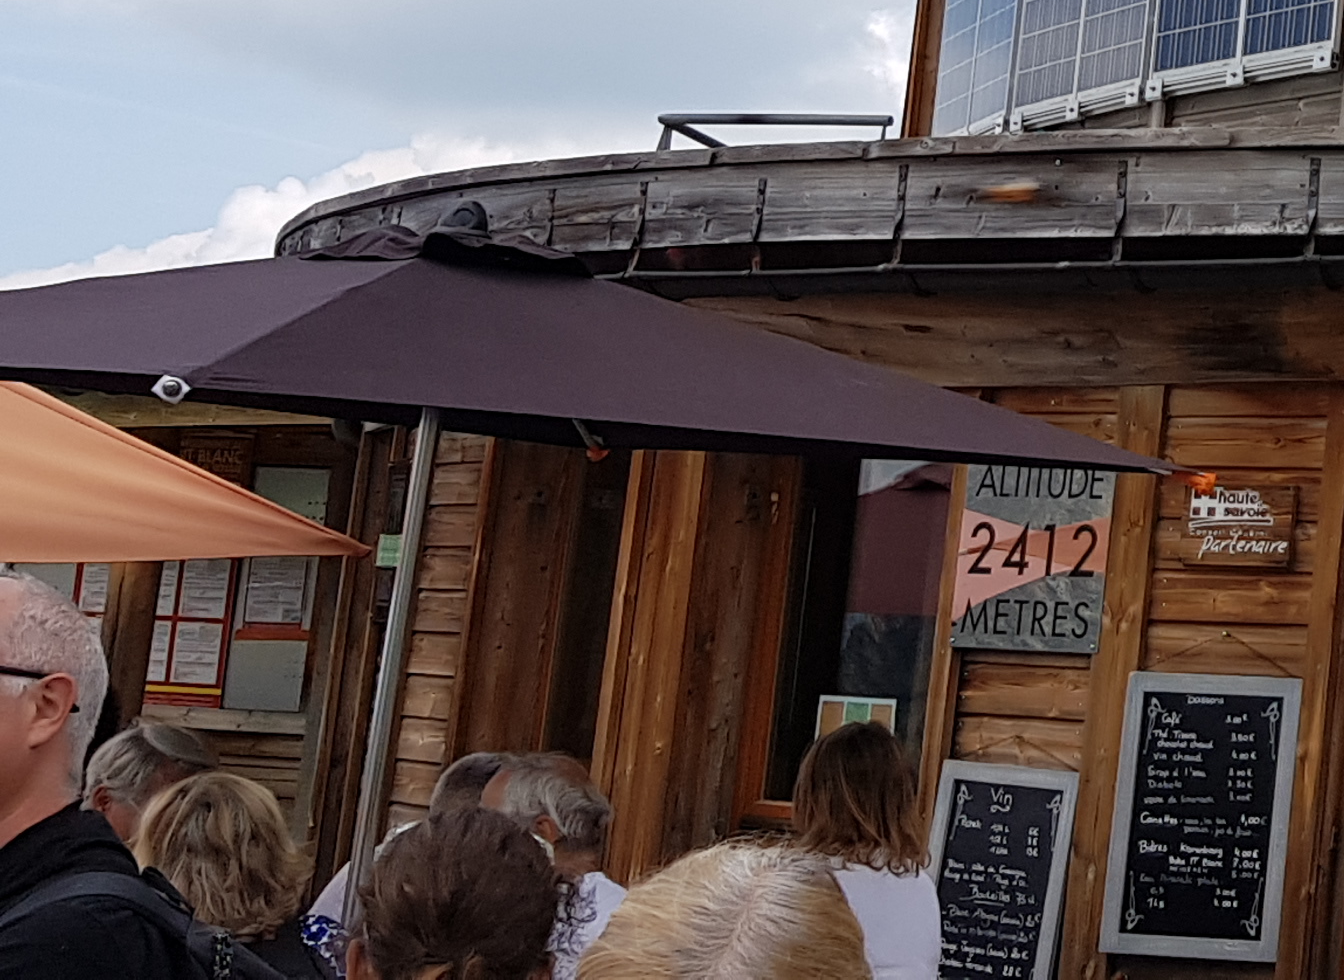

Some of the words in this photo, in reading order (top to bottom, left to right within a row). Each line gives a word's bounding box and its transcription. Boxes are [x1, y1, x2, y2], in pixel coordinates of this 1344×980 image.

[197, 448, 244, 464] BLANC
[976, 464, 1104, 499] ALTITUDE
[1218, 490, 1259, 504] haute
[1223, 506, 1269, 517] savoie
[967, 521, 1098, 577] 2412
[990, 787, 1013, 807] Vin
